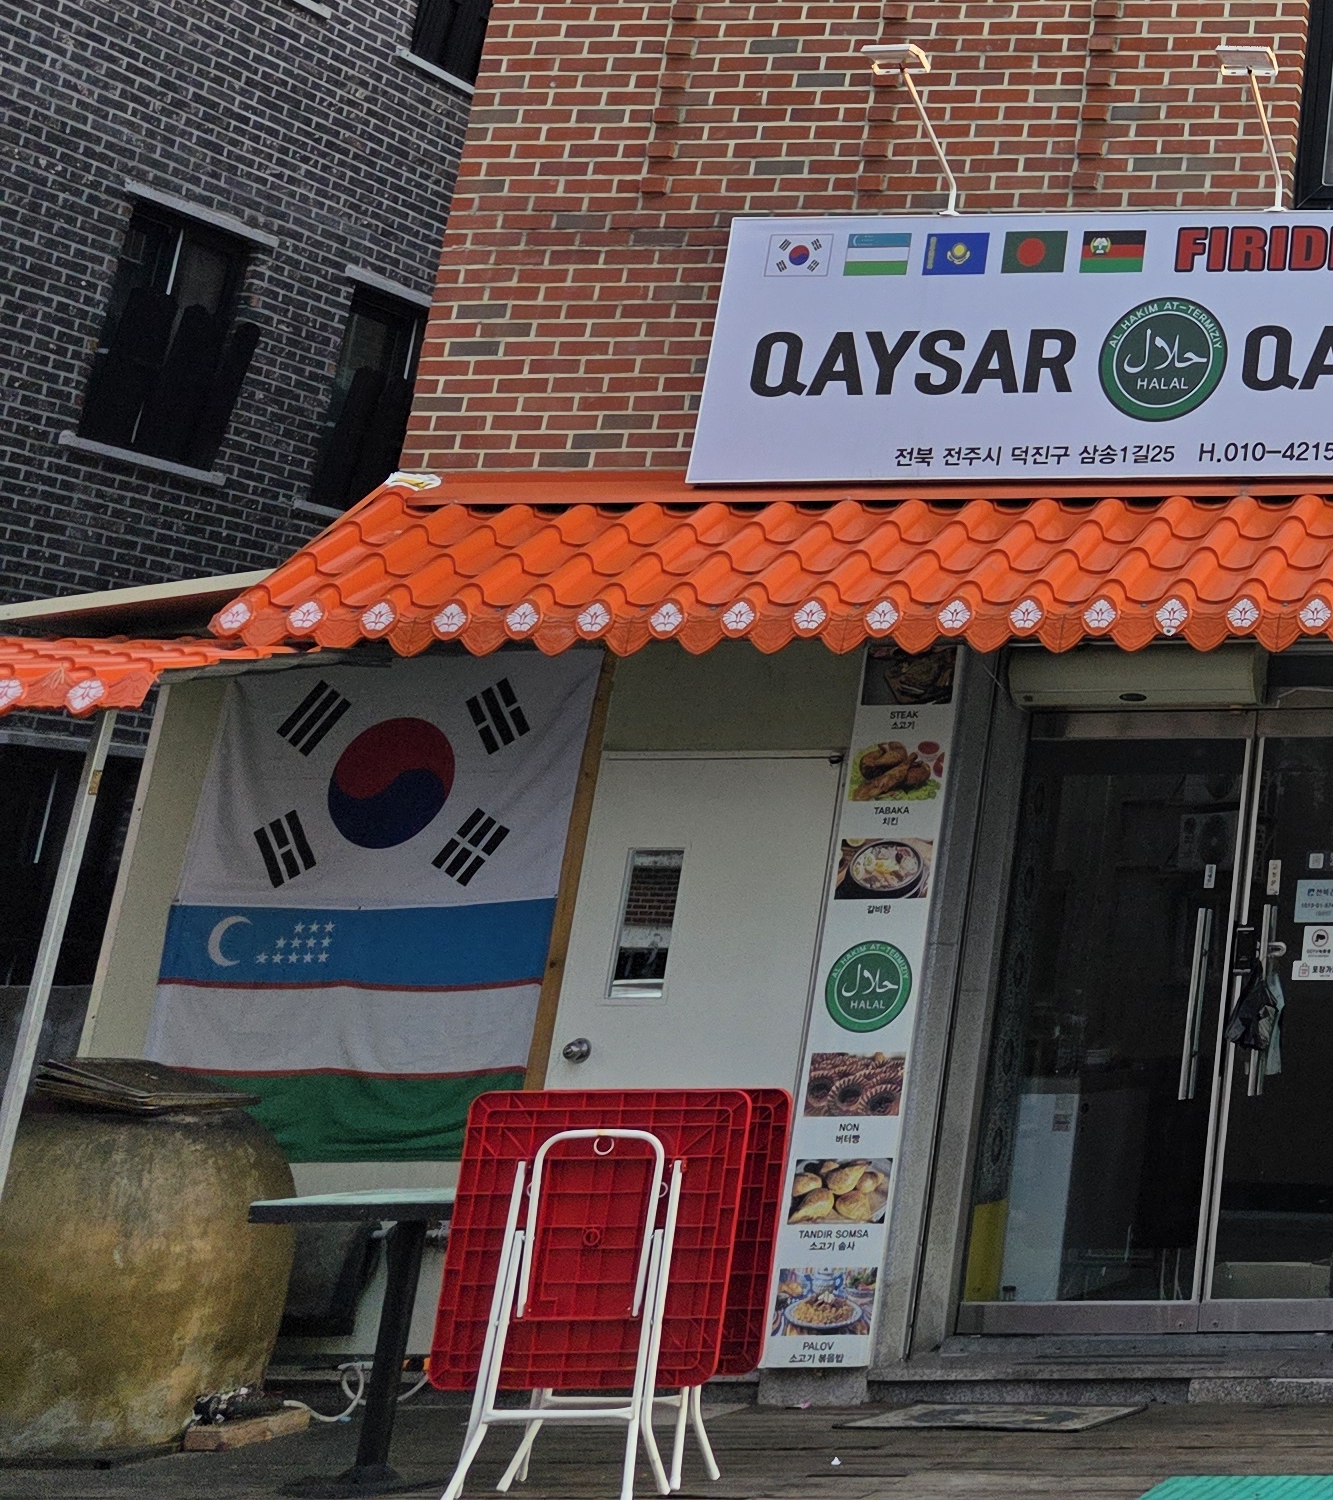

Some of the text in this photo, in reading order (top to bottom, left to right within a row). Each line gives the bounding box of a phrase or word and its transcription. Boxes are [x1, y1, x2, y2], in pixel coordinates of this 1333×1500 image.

[1109, 301, 1223, 349] AL HAKIM AT-TERMIZIY
[1123, 328, 1208, 374] حلال
[749, 329, 1076, 398] QAYSAR
[1136, 377, 1189, 390] HALAL
[894, 446, 934, 467] 전북
[942, 445, 1002, 466] 전주시
[1011, 445, 1070, 465] 덕진구
[1078, 444, 1175, 464] 삼송1길25
[889, 711, 918, 719] STEAK
[890, 721, 915, 730] 소고기
[874, 806, 910, 815] TABAKA
[882, 817, 898, 826] 치킨
[867, 905, 891, 914] 갈비탕
[831, 964, 841, 979] AL
[840, 945, 867, 965] HAKIM
[841, 963, 899, 997] حلال
[850, 1000, 886, 1009] HALAL
[839, 1123, 860, 1131] NON
[835, 1135, 860, 1144] 버터빵
[798, 1229, 869, 1239] TANDIR SOMSA
[809, 1242, 835, 1251] 소고기
[802, 1341, 834, 1351] PALOV
[789, 1353, 844, 1363] 소고기 볶음밥
